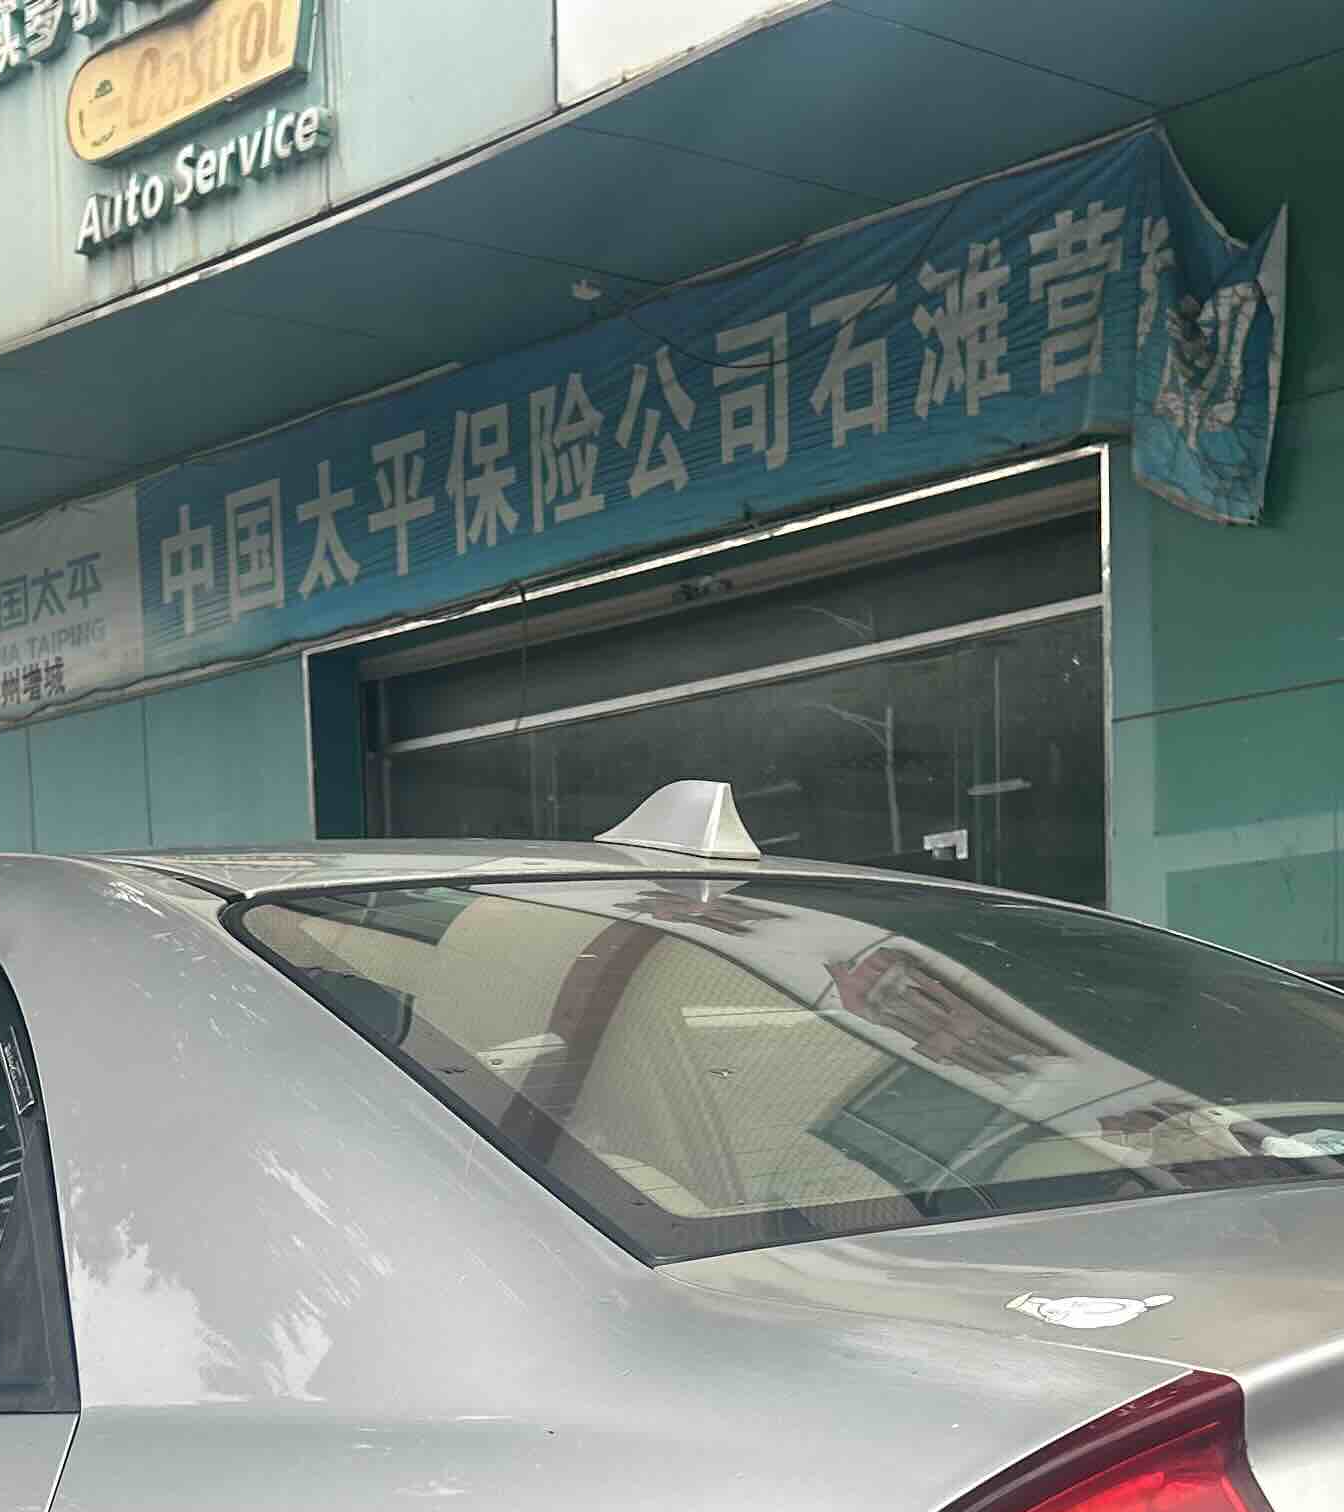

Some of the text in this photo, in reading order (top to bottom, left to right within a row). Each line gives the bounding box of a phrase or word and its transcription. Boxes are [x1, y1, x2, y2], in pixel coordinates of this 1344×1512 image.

[128, 0, 287, 130] Castrol
[76, 105, 322, 253] Auto Service
